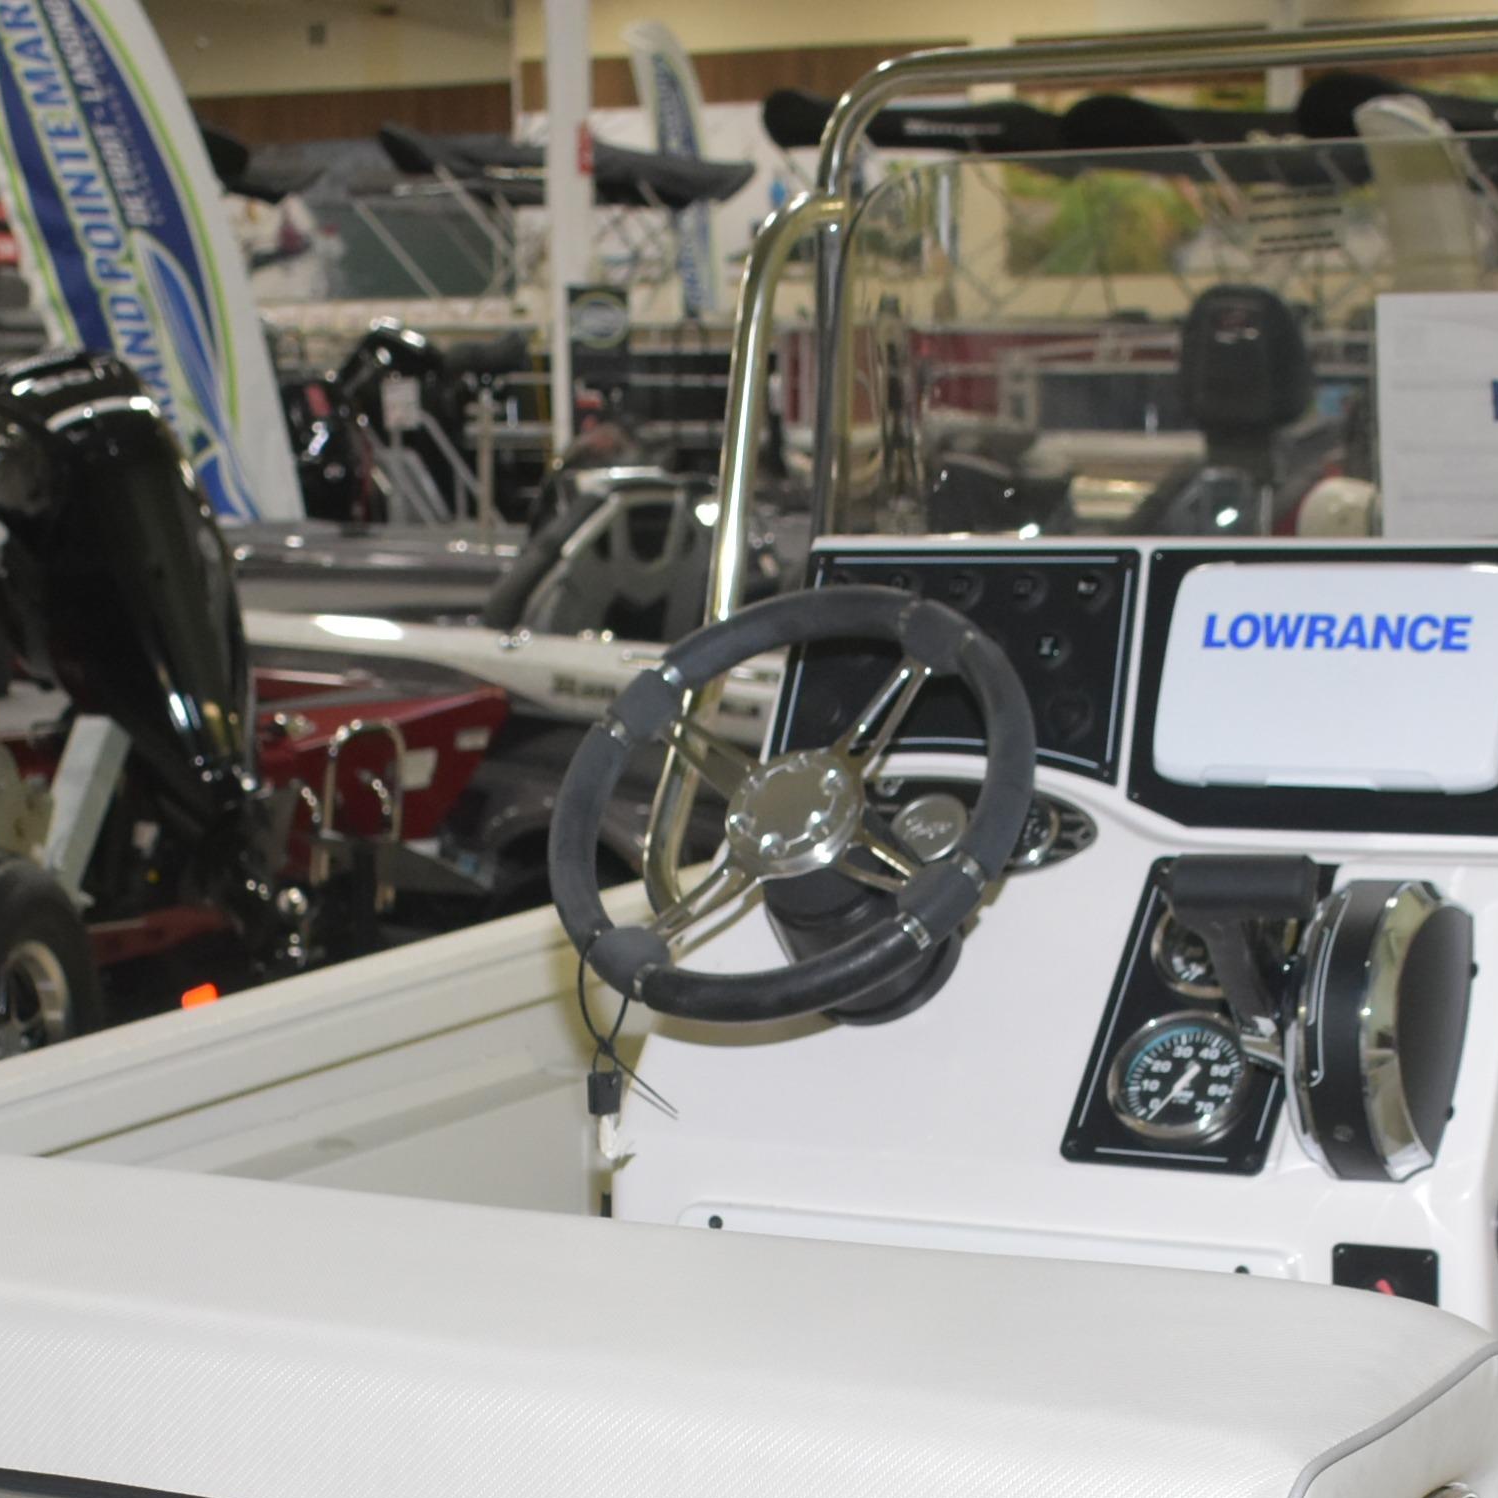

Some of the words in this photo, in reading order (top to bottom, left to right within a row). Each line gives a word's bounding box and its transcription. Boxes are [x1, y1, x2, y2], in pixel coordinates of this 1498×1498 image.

[47, 110, 134, 283] POINTE
[1202, 612, 1473, 653] LOWRANCE
[1173, 1046, 1194, 1058] 30
[1199, 1047, 1220, 1060] 40
[1151, 1060, 1172, 1073] 20
[1210, 1064, 1232, 1077] 50
[1142, 1079, 1160, 1092] 10
[1208, 1084, 1229, 1097] 60
[1195, 1101, 1215, 1114] 70
